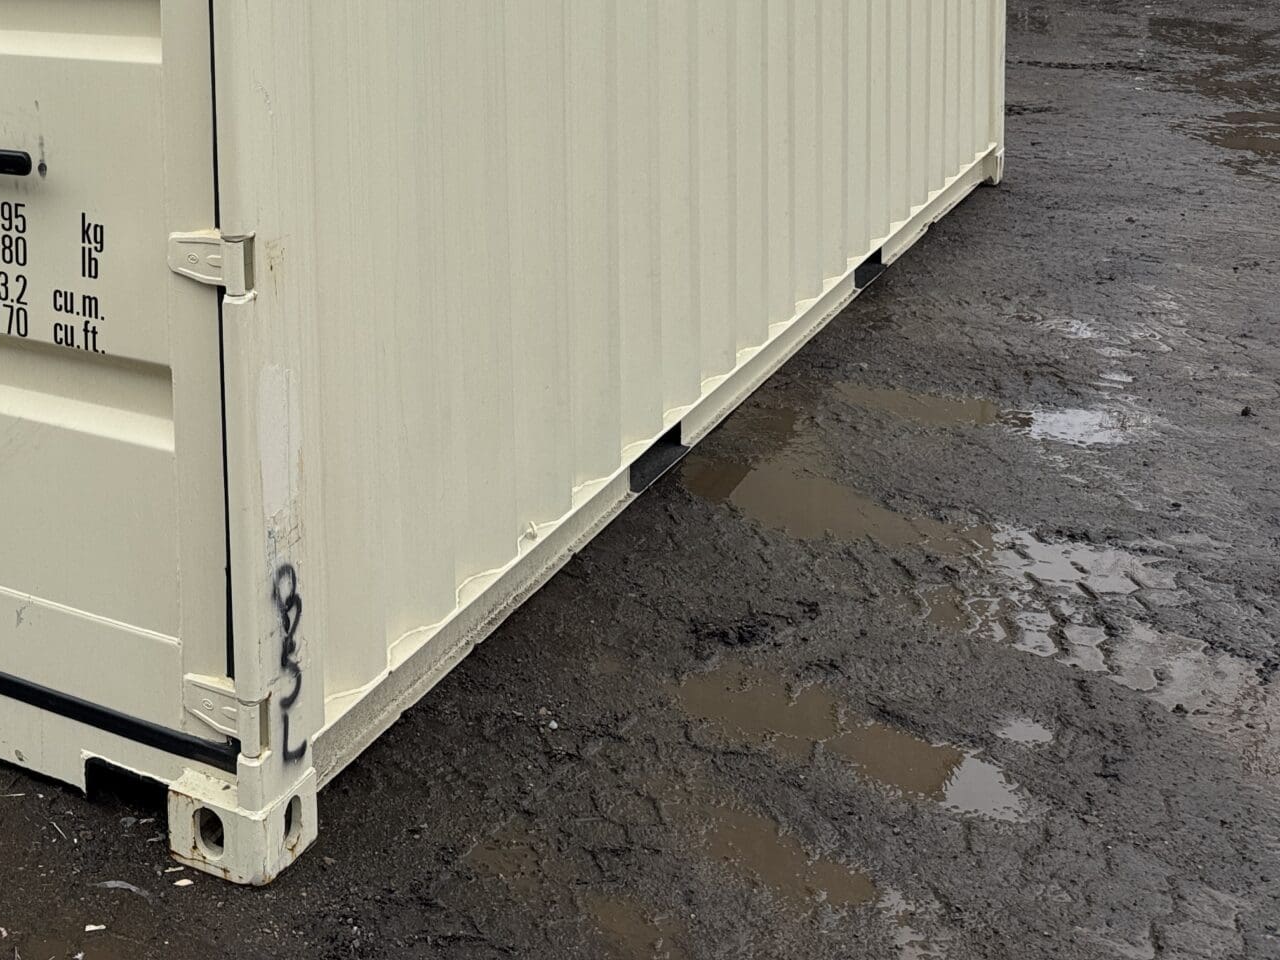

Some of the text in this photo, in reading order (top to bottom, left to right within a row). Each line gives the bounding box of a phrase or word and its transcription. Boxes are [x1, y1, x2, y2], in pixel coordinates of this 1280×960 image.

[81, 212, 104, 252] kg
[81, 246, 99, 279] lb
[53, 289, 105, 321] cu.m.
[53, 321, 105, 354] cu.ft.
